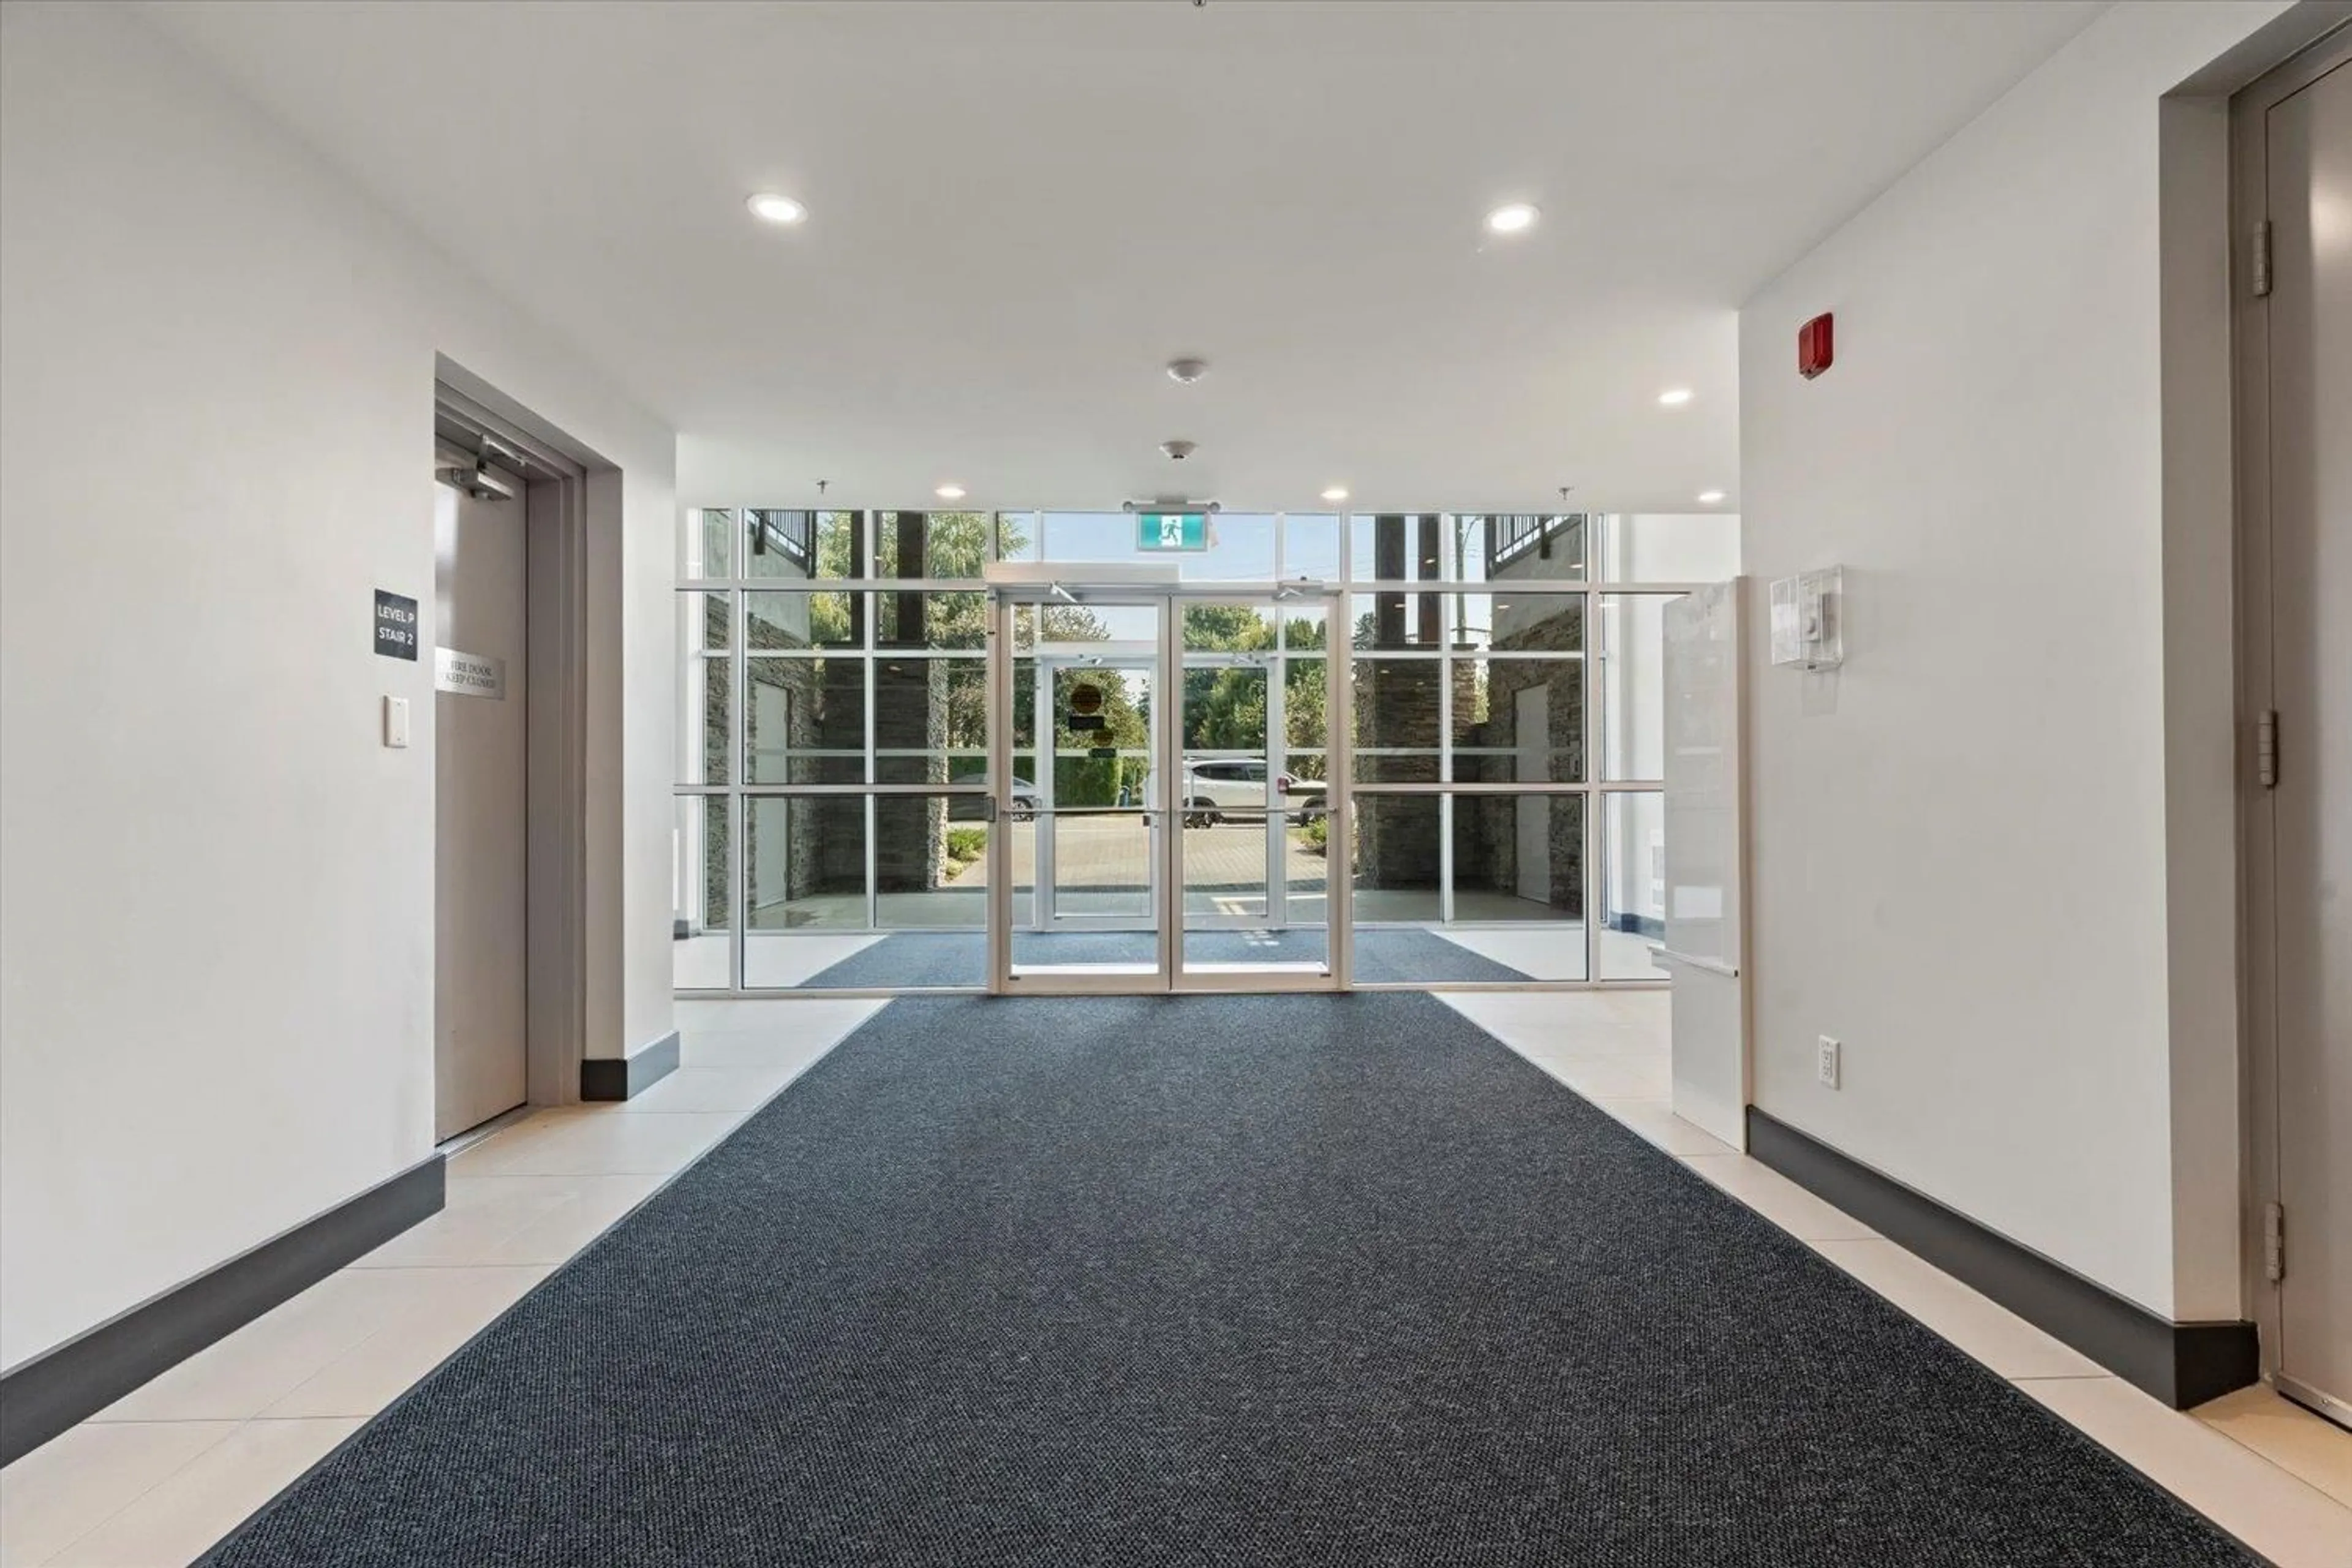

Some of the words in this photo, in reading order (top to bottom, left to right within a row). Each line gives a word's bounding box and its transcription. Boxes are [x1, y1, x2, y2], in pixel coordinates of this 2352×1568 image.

[377, 604, 407, 623] LEVEL
[408, 612, 415, 624] P
[379, 627, 405, 644] STAIR
[407, 633, 414, 646] 2
